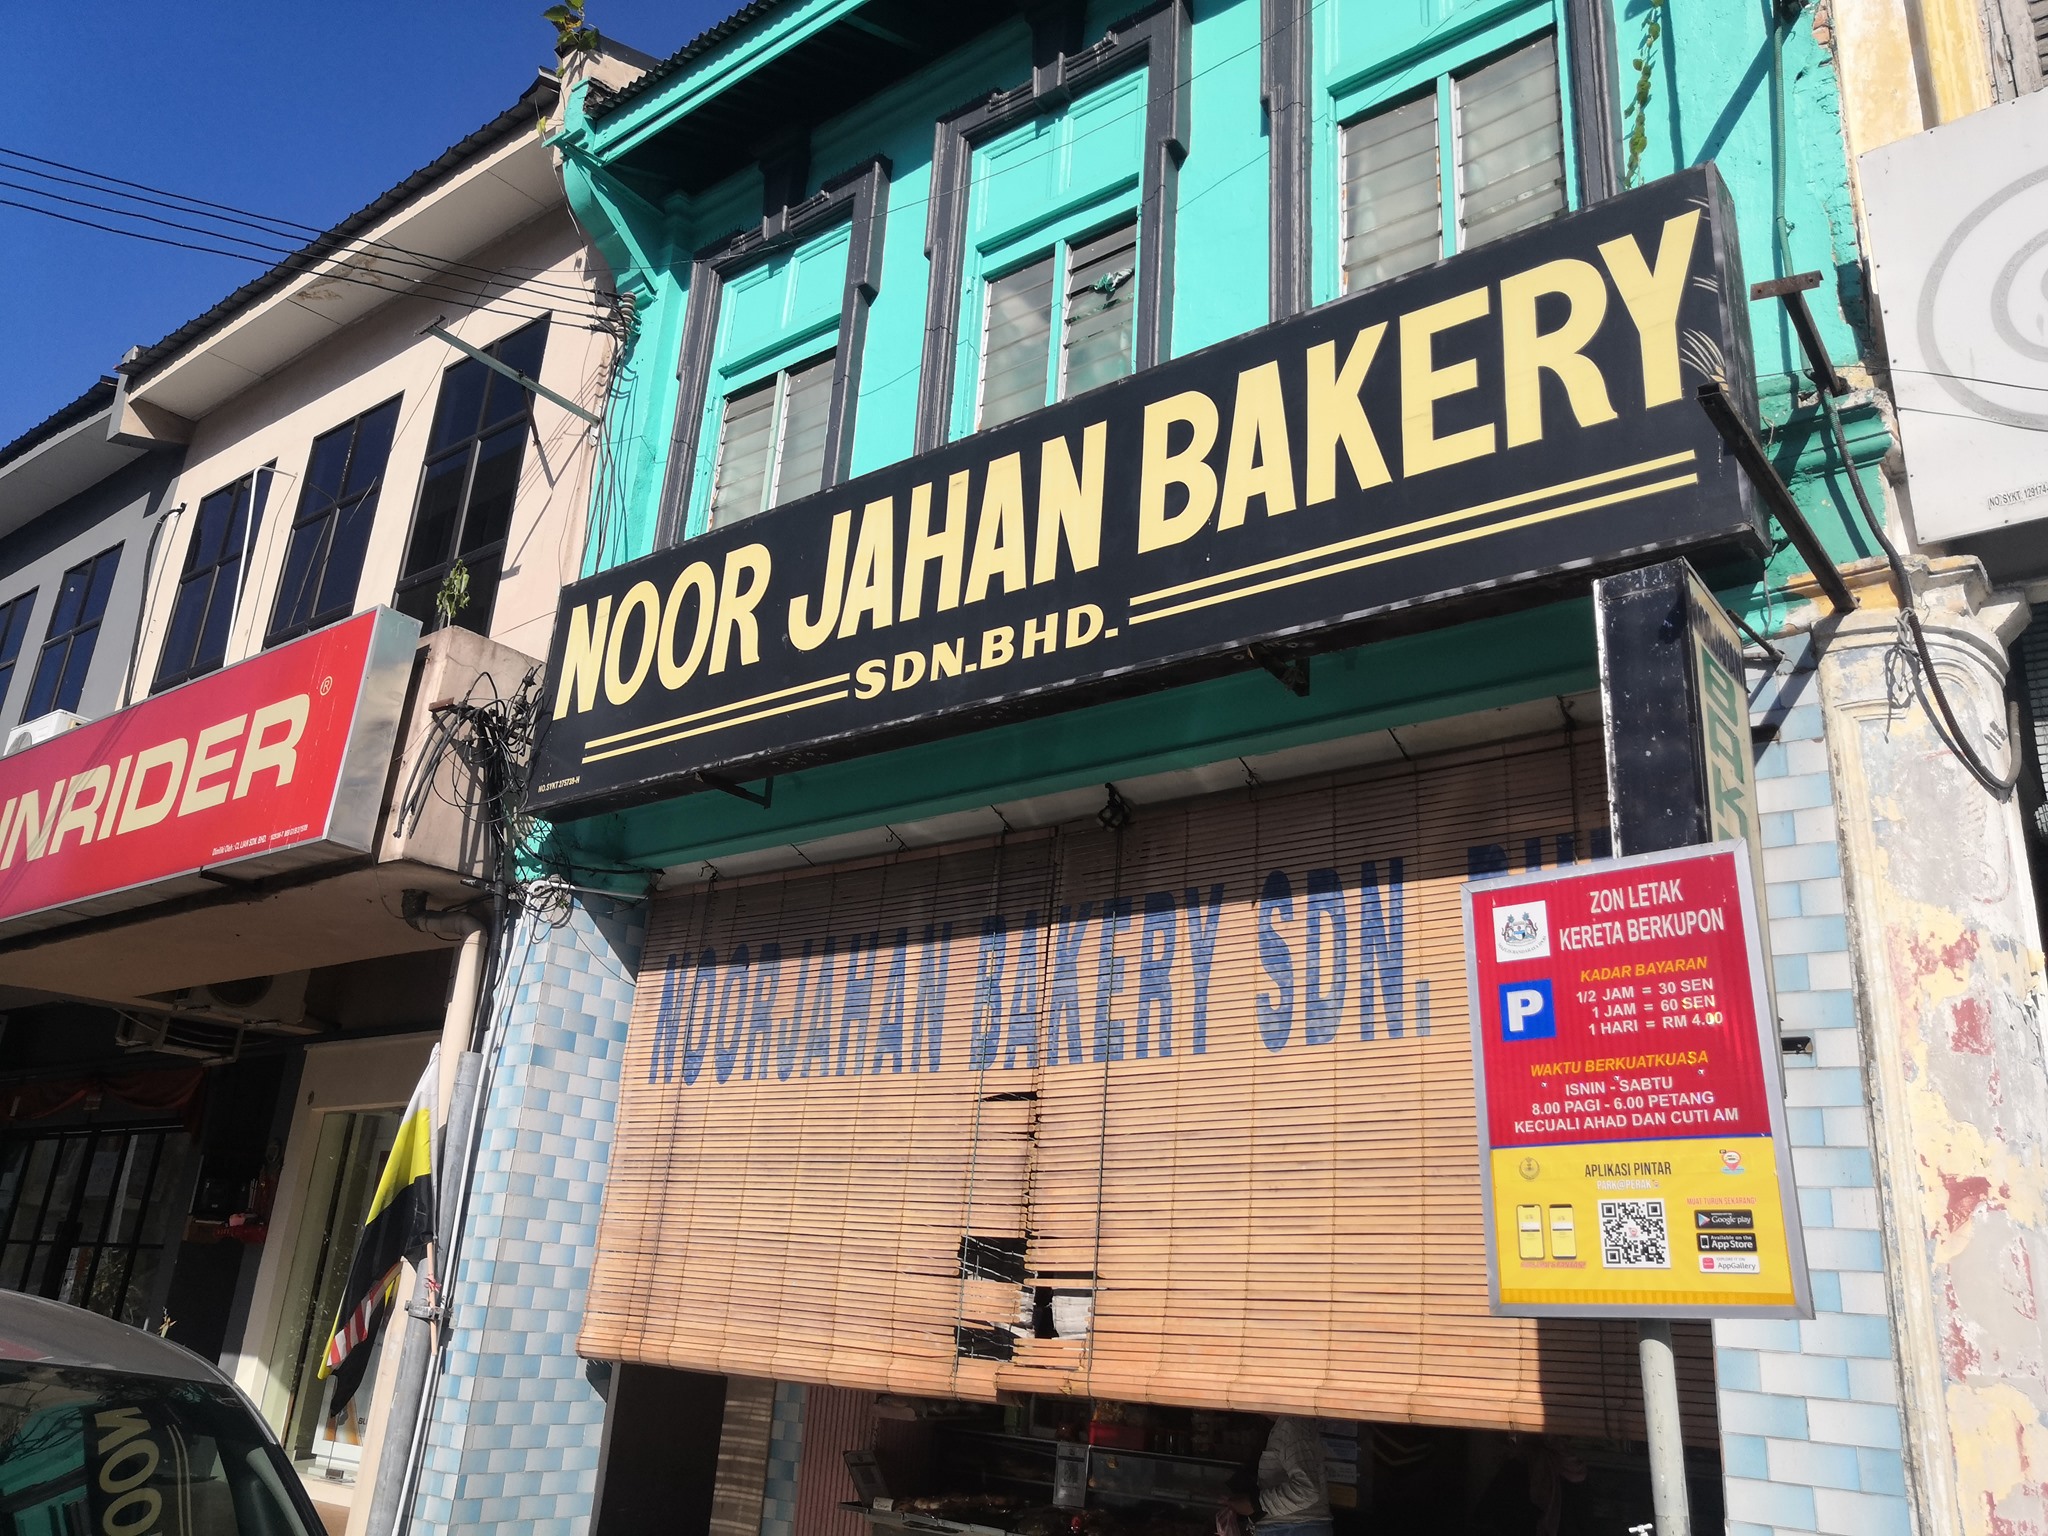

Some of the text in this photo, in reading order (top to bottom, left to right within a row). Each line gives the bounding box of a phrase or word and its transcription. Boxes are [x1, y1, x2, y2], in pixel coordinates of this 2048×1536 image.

[552, 208, 1702, 721] NOOR JAHAN BAKERY
[854, 603, 1118, 700] SDN.BHD.
[1590, 879, 1684, 914] ZON LETAK
[1559, 907, 1725, 951] KERETA BERKUPON
[969, 883, 1225, 1071] BAKERY
[1256, 856, 1431, 1053] SDN.
[1580, 956, 1708, 983] KADAR BAYARAN
[1576, 990, 1597, 1004] 1/2
[1602, 986, 1635, 1000] JAM
[1658, 981, 1677, 995] 30
[1680, 978, 1714, 993] SEN
[1506, 989, 1544, 1032] P
[1591, 1006, 1599, 1019] 1
[1604, 1004, 1637, 1018] JAM
[1660, 999, 1679, 1012] 60
[1682, 995, 1716, 1010] SEN
[1588, 1023, 1596, 1036] 1
[1600, 1020, 1639, 1035] HARI
[1662, 1016, 1688, 1029] RM
[1691, 1012, 1723, 1026] 4.00
[1530, 1050, 1709, 1077] WAKTU BERKUATKUASA
[1565, 1081, 1606, 1096] ISNIN
[1619, 1076, 1674, 1093] SABTU
[1532, 1102, 1560, 1116] 8.00
[1564, 1099, 1601, 1114] PAGI
[1613, 1095, 1645, 1110] 6.00
[1648, 1091, 1715, 1108] PETANG
[1514, 1107, 1739, 1134] KECUALI AHAD DAN CUTI AM
[1584, 1161, 1672, 1178] APLIKASI PINTAR
[1597, 1179, 1652, 1191] PARK@PERAK
[1711, 1215, 1752, 1225] Google play
[1711, 1240, 1753, 1250] App Store
[1717, 1262, 1757, 1271] AppGallery
